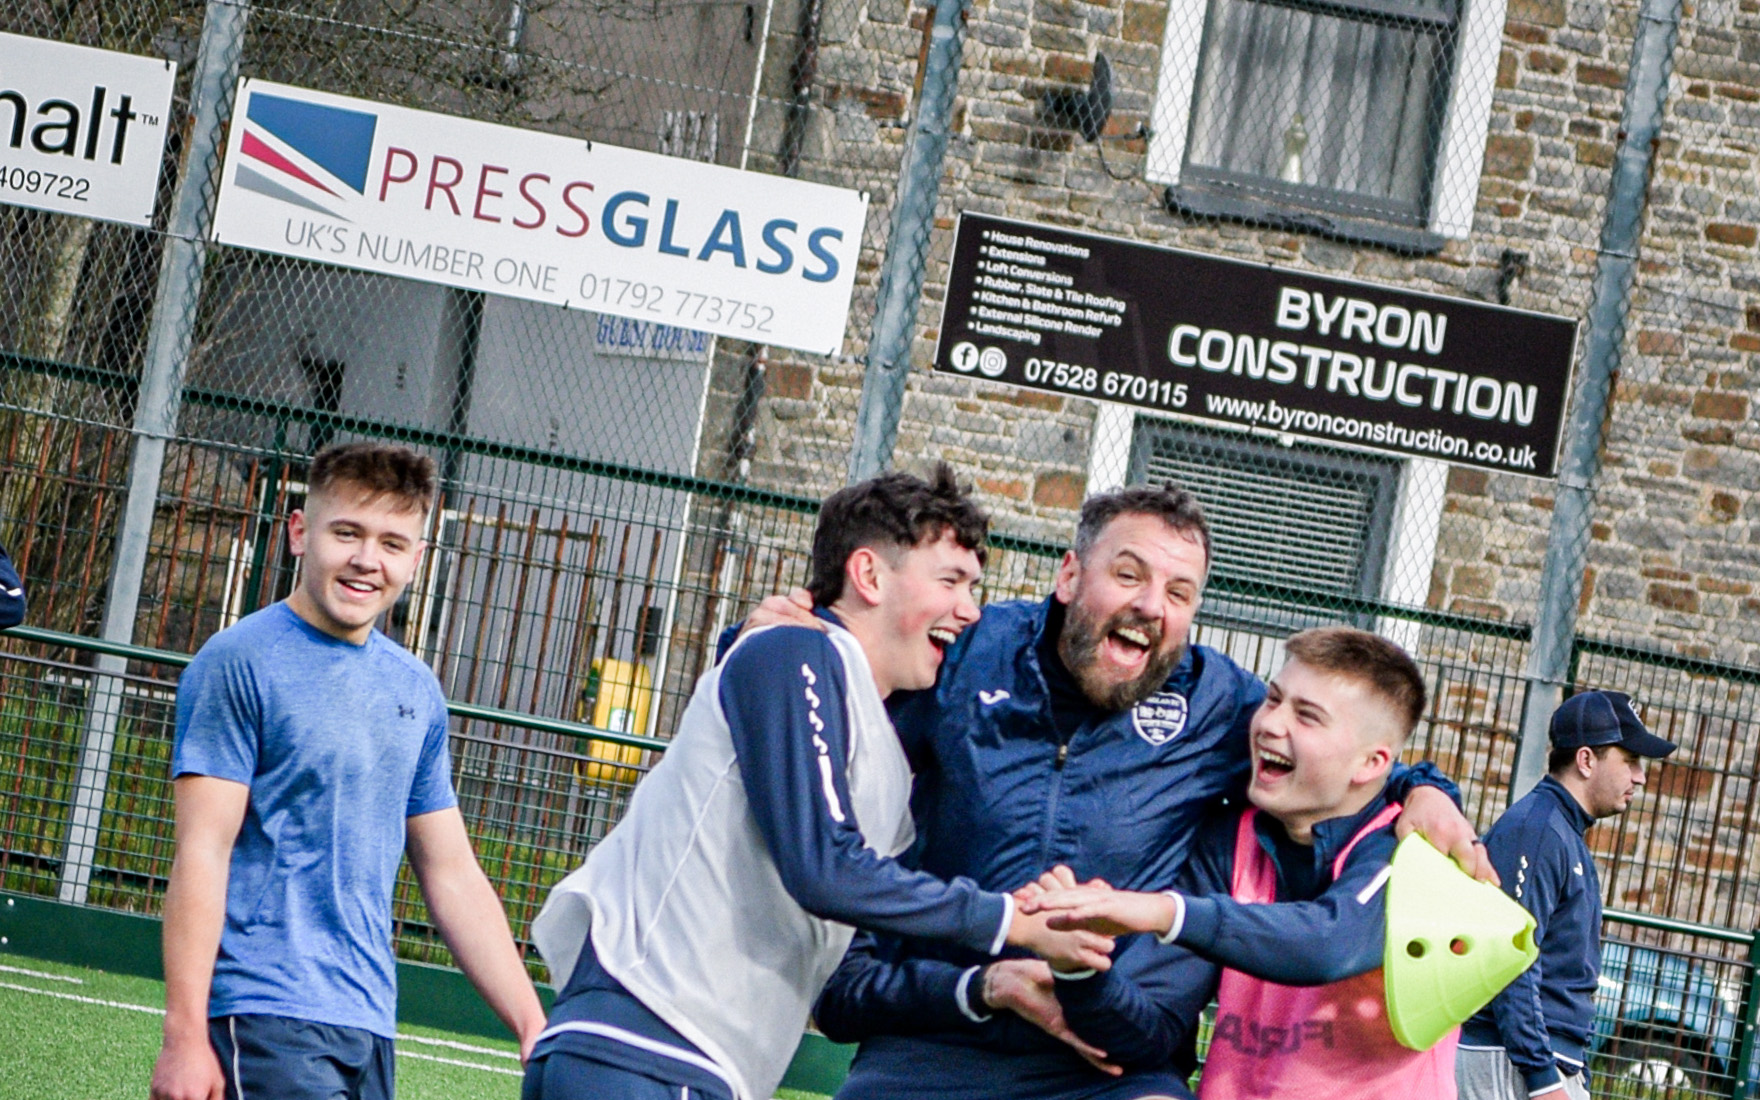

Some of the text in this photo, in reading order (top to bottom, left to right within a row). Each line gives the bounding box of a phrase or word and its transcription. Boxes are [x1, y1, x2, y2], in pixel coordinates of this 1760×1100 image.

[379, 147, 844, 284] PRESSGLASS
[988, 245, 1047, 266] Extensions
[990, 230, 1091, 259] House Renovations
[285, 218, 775, 333] UK'S NUMBER ONE 01792 773752
[986, 260, 1074, 287] Loft Conversions
[981, 290, 1122, 327] Kitchen & Bathroom Refurb
[983, 275, 1126, 314] Rubber, Slate & Tile Roofing
[976, 320, 1042, 346] Landscaping
[978, 305, 1103, 338] External Silicone Render
[1275, 286, 1448, 355] BYRON
[1168, 323, 1538, 426] CONSTRUCTION
[1024, 357, 1538, 469] 07528 670115 www.byronconstruction.co.uk
